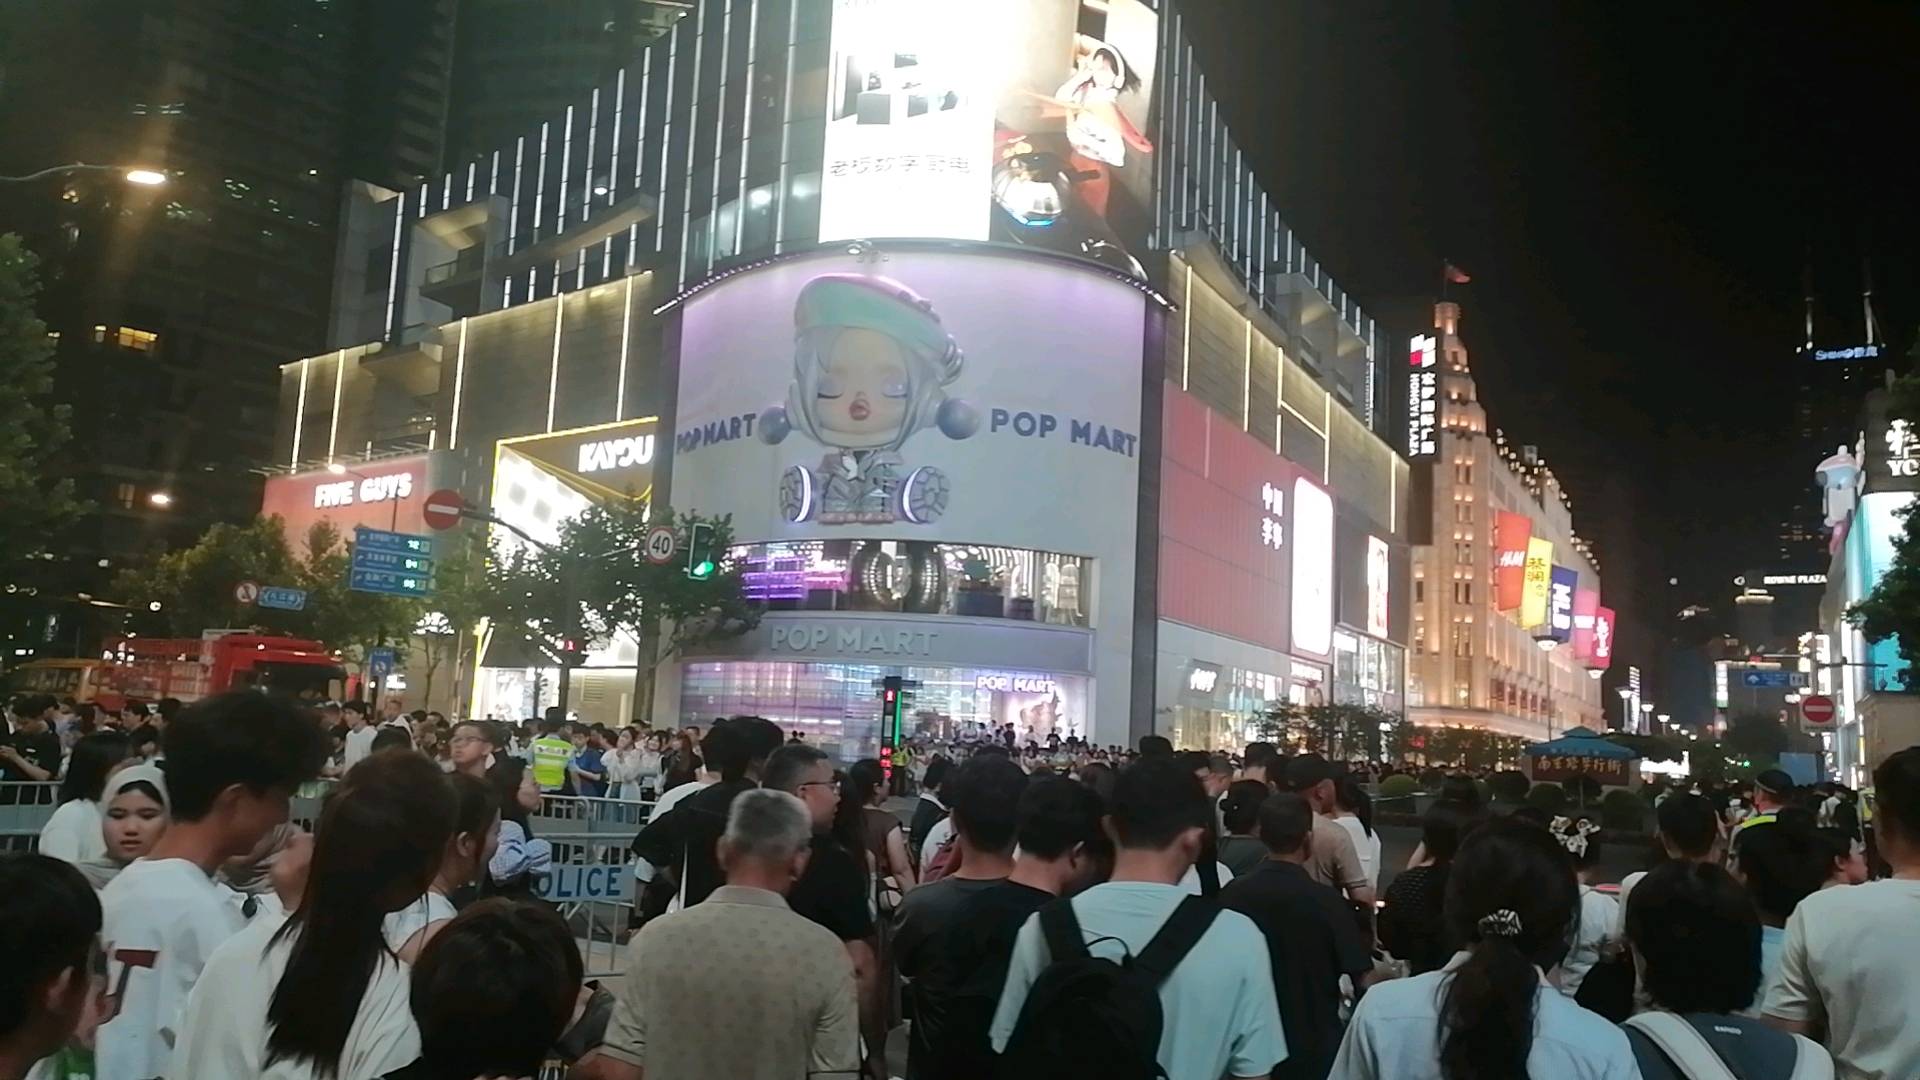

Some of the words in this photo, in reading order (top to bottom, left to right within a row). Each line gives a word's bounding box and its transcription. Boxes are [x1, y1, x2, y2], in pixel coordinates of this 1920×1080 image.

[1409, 373, 1420, 417] HONGYI
[676, 428, 701, 455] POP
[704, 413, 757, 447] MART
[991, 408, 1057, 438] POP
[1070, 419, 1137, 458] MART
[1408, 420, 1420, 457] PLAZA
[314, 481, 354, 509] FIVE
[360, 472, 412, 502] GUYS
[652, 535, 670, 554] 40
[1797, 574, 1828, 584] PLAZA
[1552, 583, 1571, 630] MLB
[771, 625, 829, 651] POP
[836, 626, 939, 656] MART
[977, 676, 1007, 690] POP
[1013, 678, 1056, 693] MART
[536, 867, 622, 897] OLICE
